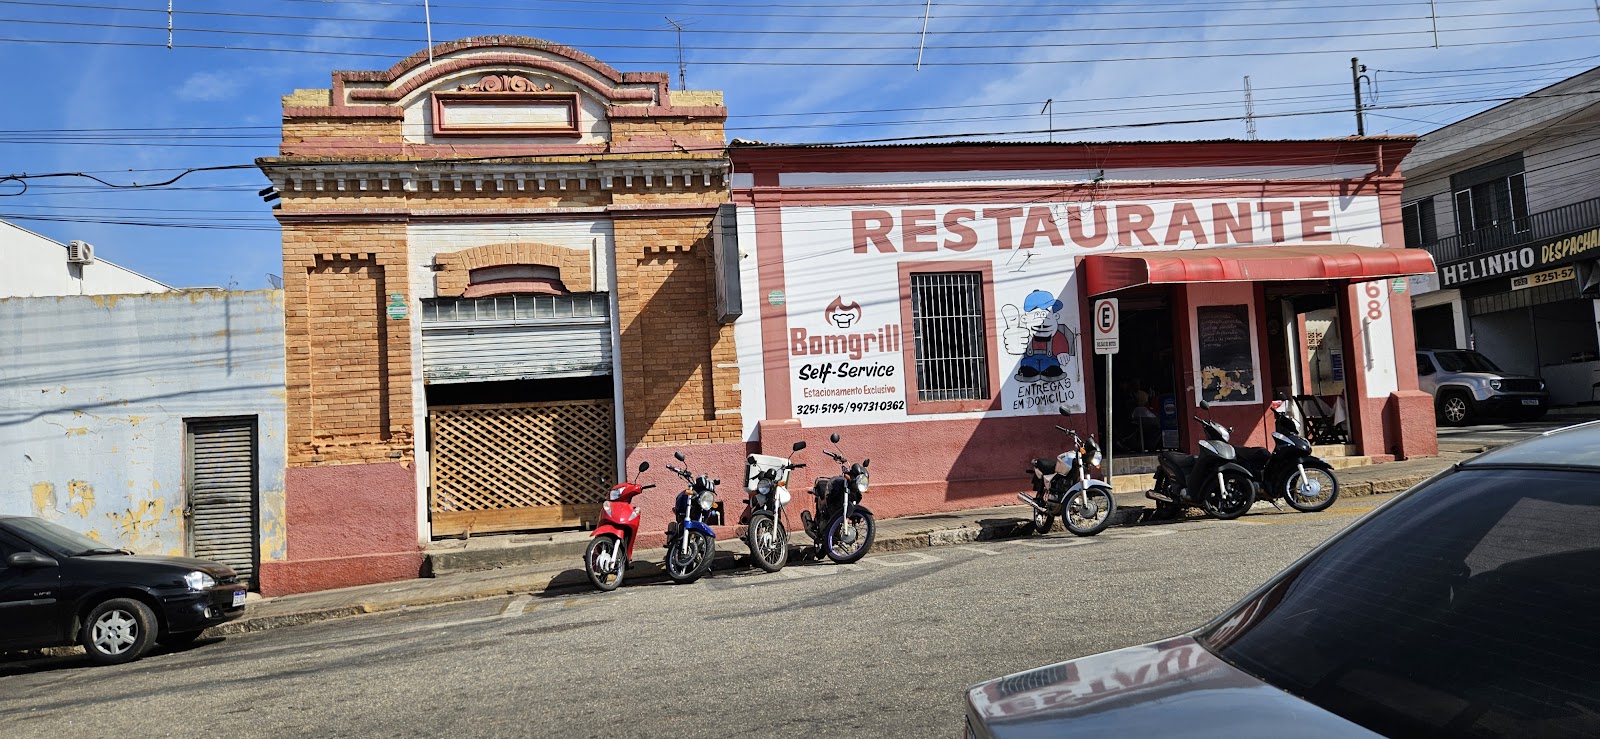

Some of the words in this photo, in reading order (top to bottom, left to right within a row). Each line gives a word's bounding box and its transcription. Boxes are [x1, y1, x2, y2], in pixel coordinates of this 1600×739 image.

[851, 200, 1333, 254] RESTAURANTE
[1442, 247, 1535, 286] HELINHO
[1102, 307, 1110, 327] E
[790, 324, 900, 360] Bomgrill
[798, 362, 895, 383] Self-Service
[803, 387, 862, 398] Estacionamento
[863, 384, 896, 395] Exclusivo
[1018, 378, 1071, 398] ENTREGAS
[1013, 399, 1024, 410] EM
